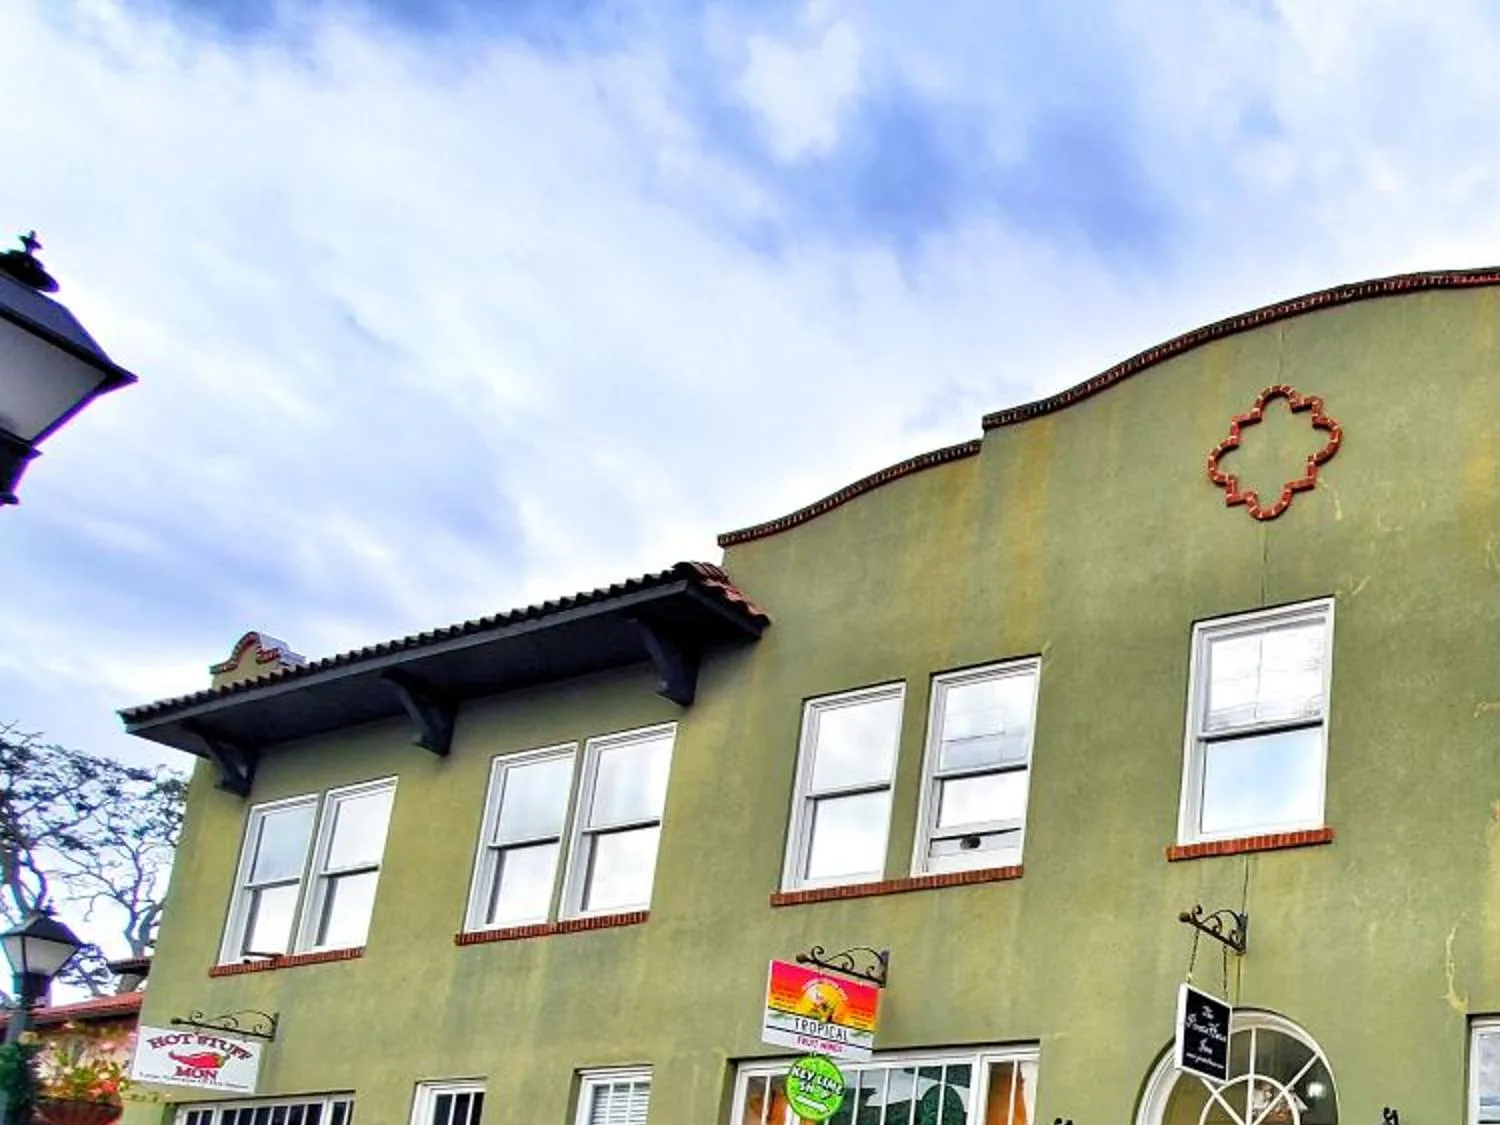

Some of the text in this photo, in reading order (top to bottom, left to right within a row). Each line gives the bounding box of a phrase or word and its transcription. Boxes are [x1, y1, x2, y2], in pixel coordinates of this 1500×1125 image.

[794, 1017, 848, 1042] TROPICAL
[147, 1032, 253, 1060] HOT STUFF
[174, 1066, 218, 1080] MON
[791, 1066, 843, 1095] KEY LIME
